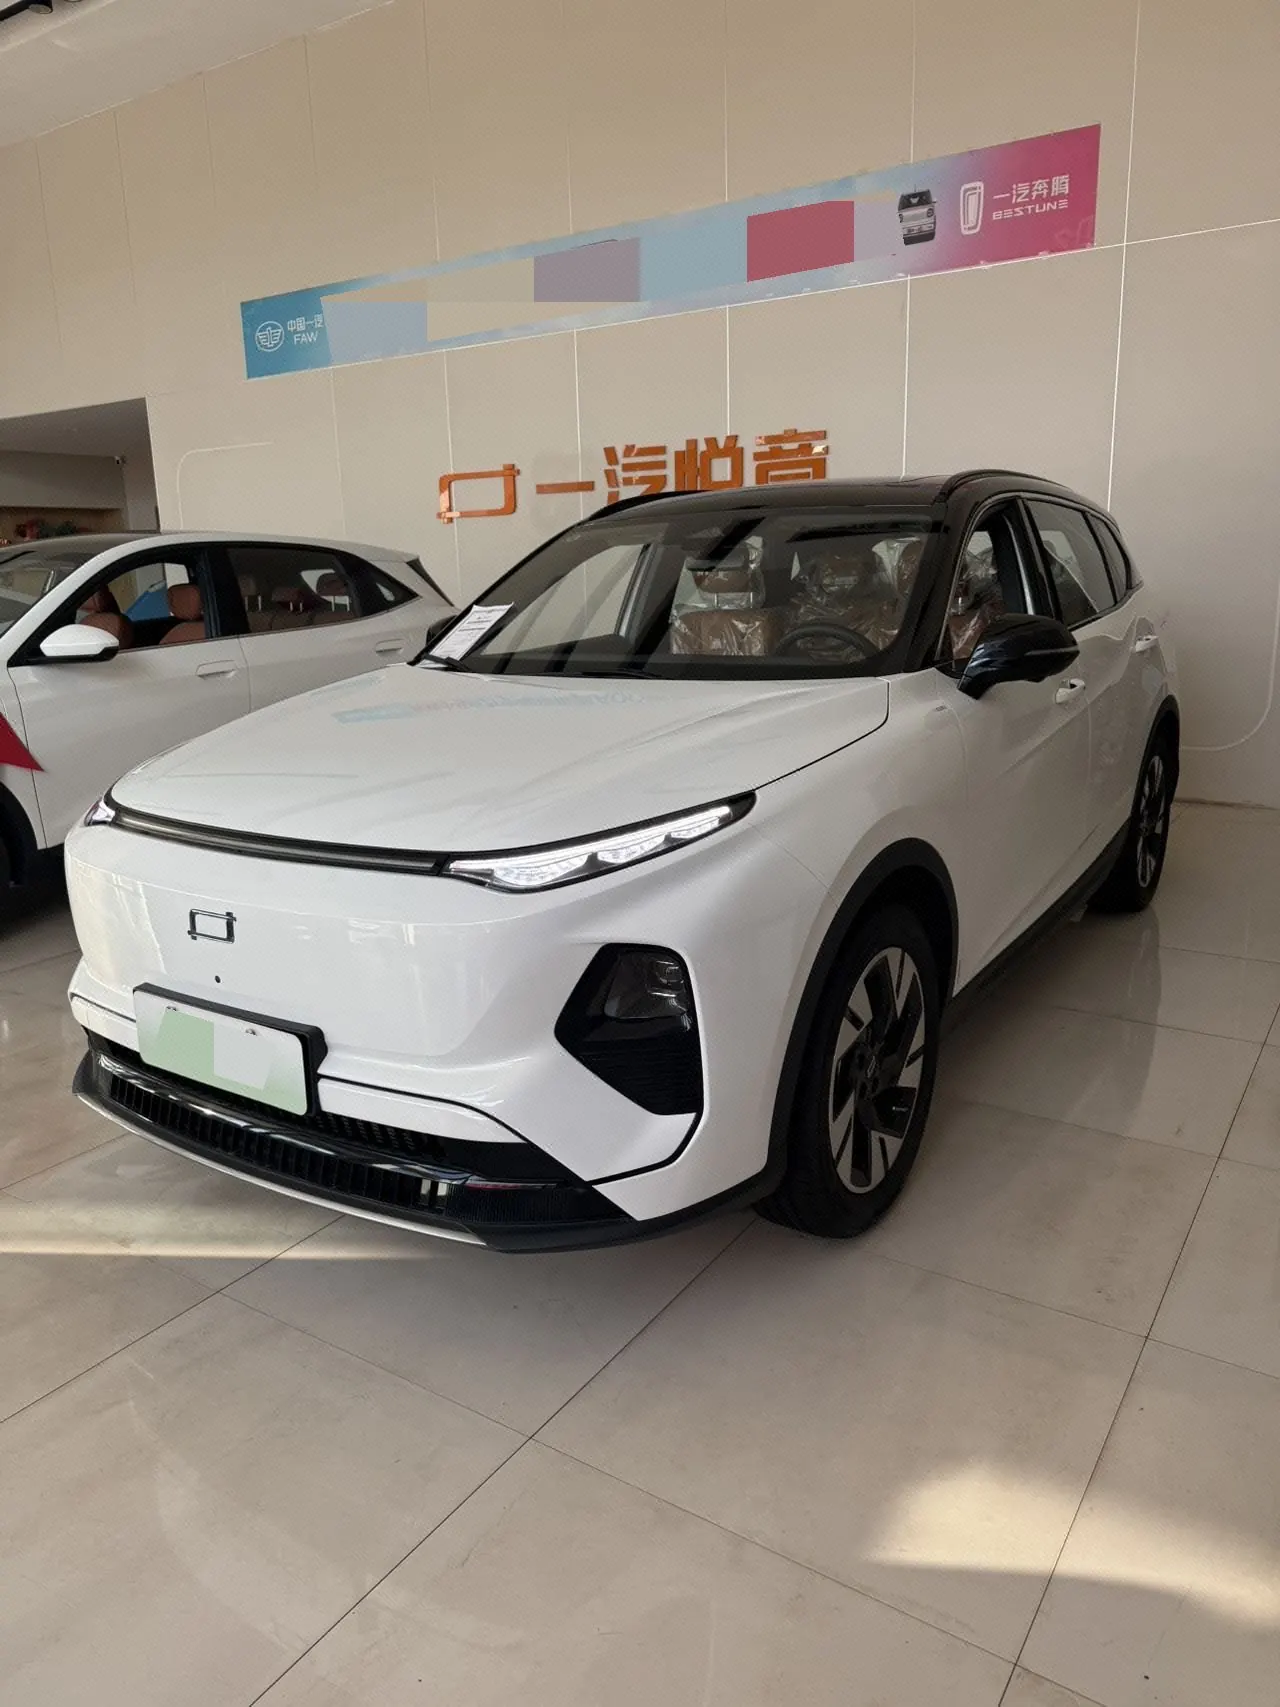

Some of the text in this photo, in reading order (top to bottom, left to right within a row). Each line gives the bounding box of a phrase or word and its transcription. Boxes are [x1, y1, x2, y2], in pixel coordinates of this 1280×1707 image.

[992, 174, 1070, 204] 一汽奔腾
[992, 199, 1069, 221] BESTUNE
[287, 313, 325, 332] 中国一汽
[293, 331, 319, 345] FAW
